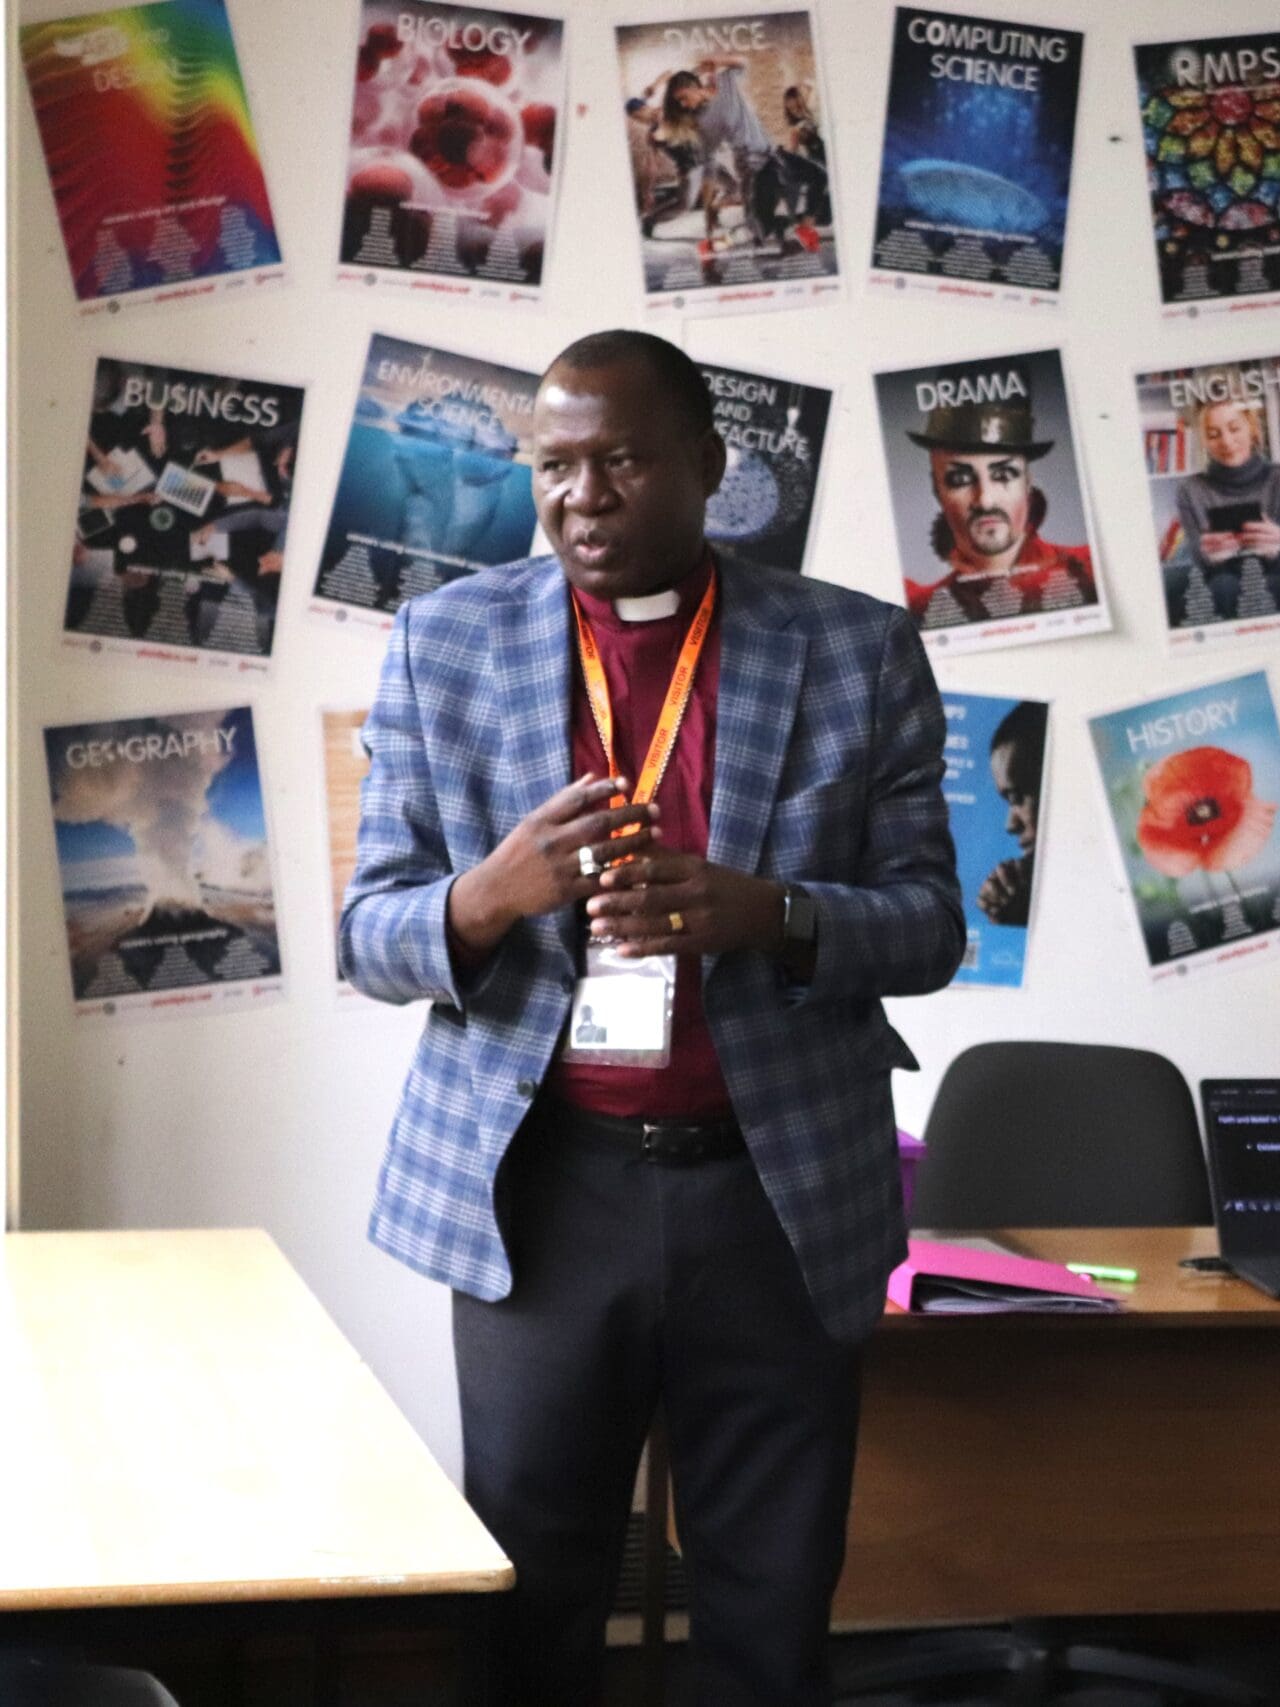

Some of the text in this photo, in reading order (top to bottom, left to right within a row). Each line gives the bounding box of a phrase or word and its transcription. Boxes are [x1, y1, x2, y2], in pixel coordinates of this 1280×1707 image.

[397, 13, 532, 57] BIOLOGY
[663, 21, 767, 55] DANCE
[908, 18, 1068, 63] COMPUTING
[930, 52, 1039, 91] SCIENCE
[377, 353, 535, 414] ENVIRONMENTA
[916, 371, 1027, 411] DRAMA
[713, 400, 752, 422] AND
[688, 607, 710, 646] VISITOR
[670, 665, 689, 706] VISITOR
[1125, 698, 1238, 753] HISTORY
[648, 728, 668, 769] VISITOR
